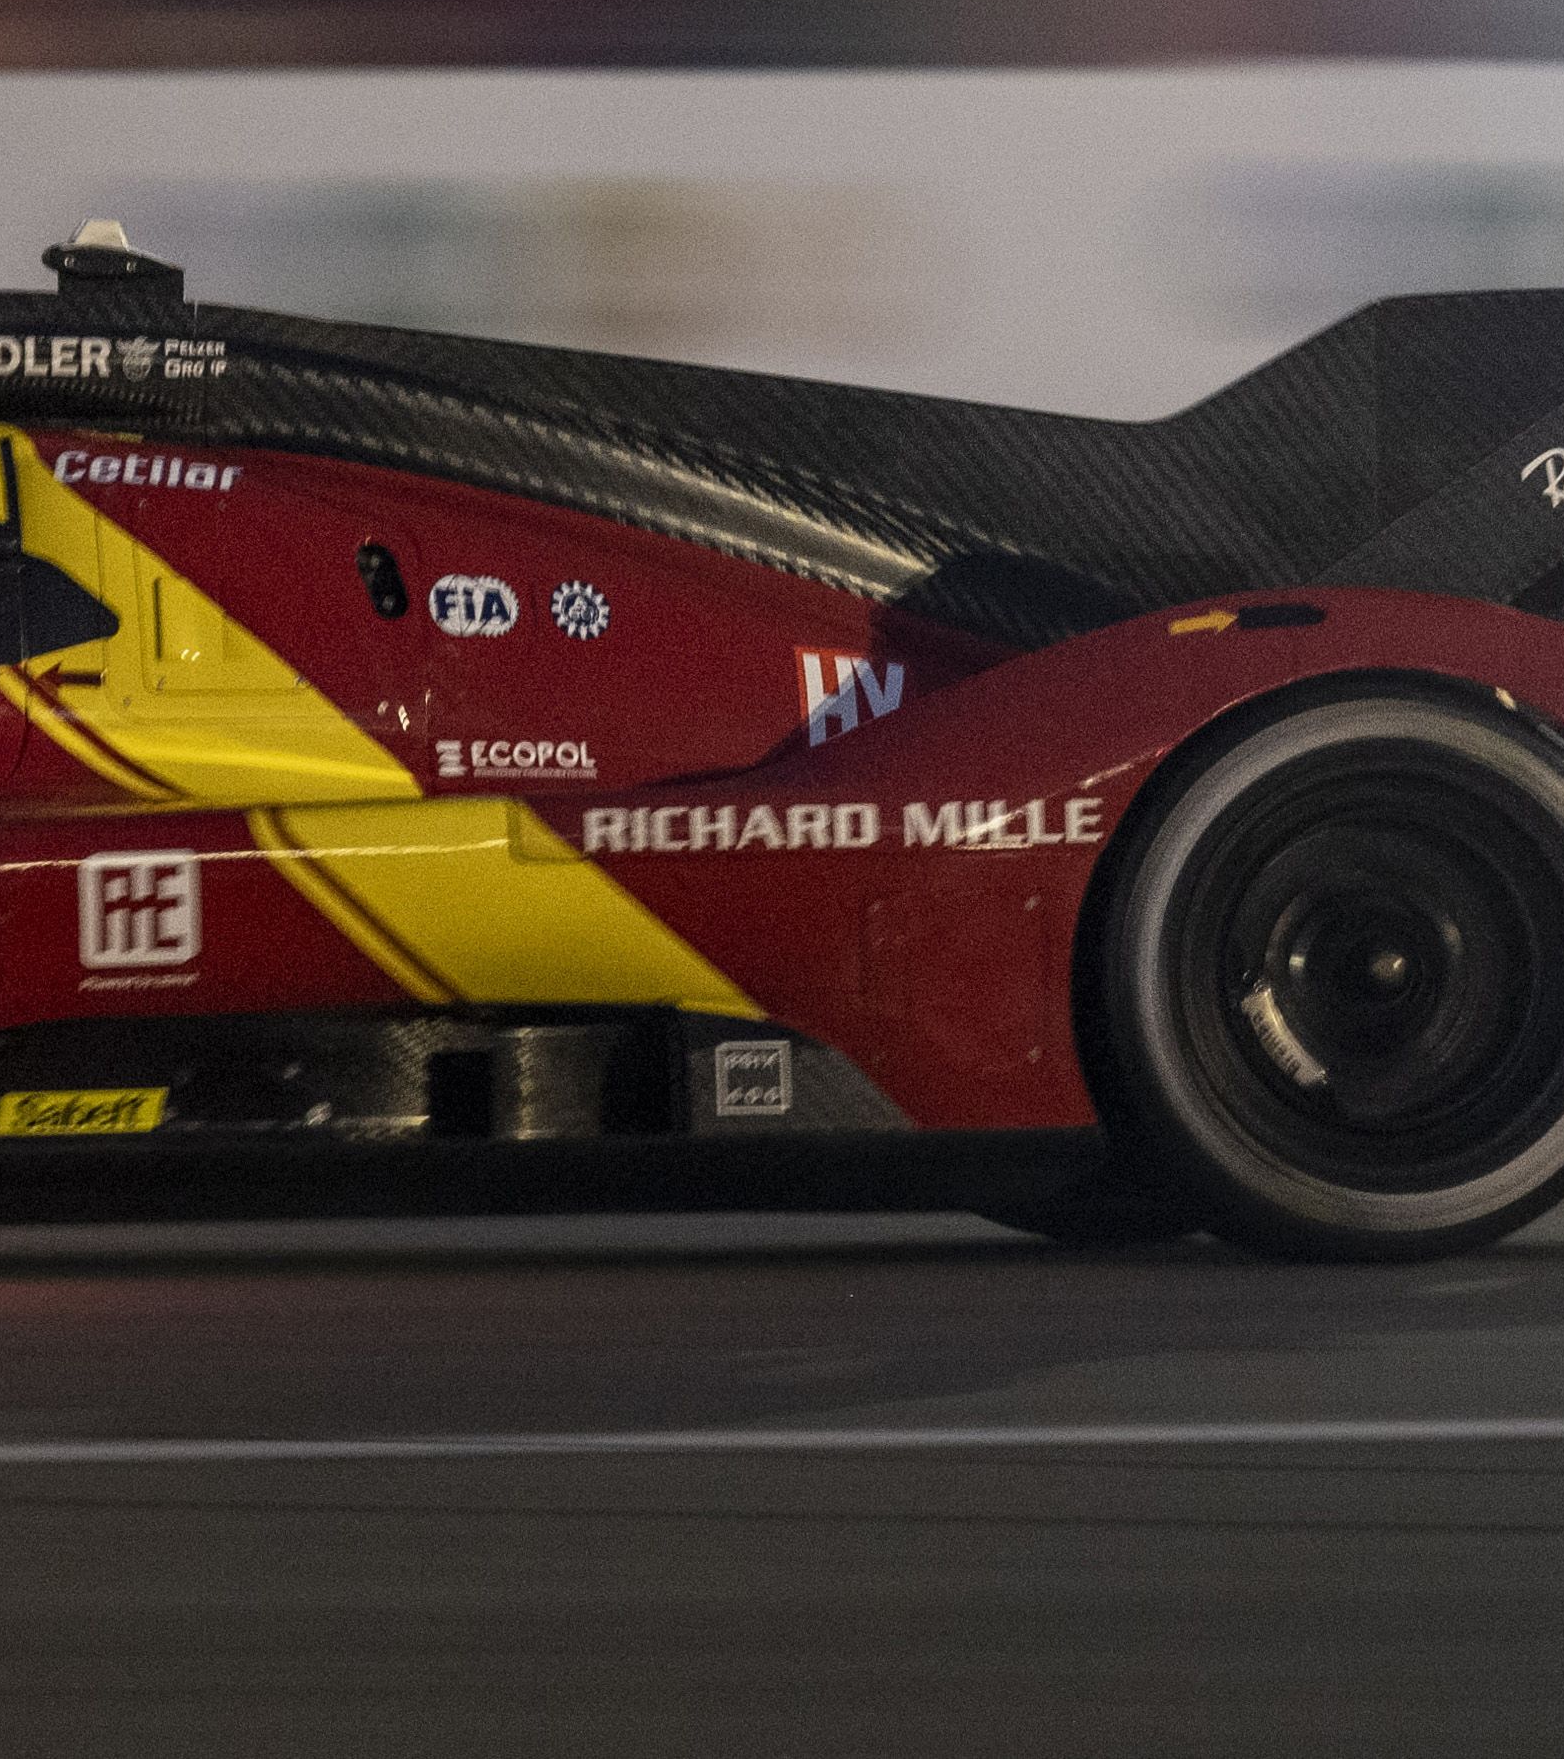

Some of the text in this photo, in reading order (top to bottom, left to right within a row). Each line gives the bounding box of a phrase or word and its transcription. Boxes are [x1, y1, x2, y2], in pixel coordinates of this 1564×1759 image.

[165, 339, 226, 356] PELZER
[54, 450, 245, 491] Cetilar
[435, 589, 511, 624] FIA
[470, 740, 597, 769] ECOPOL
[582, 798, 1105, 855] RICHARD MILLE
